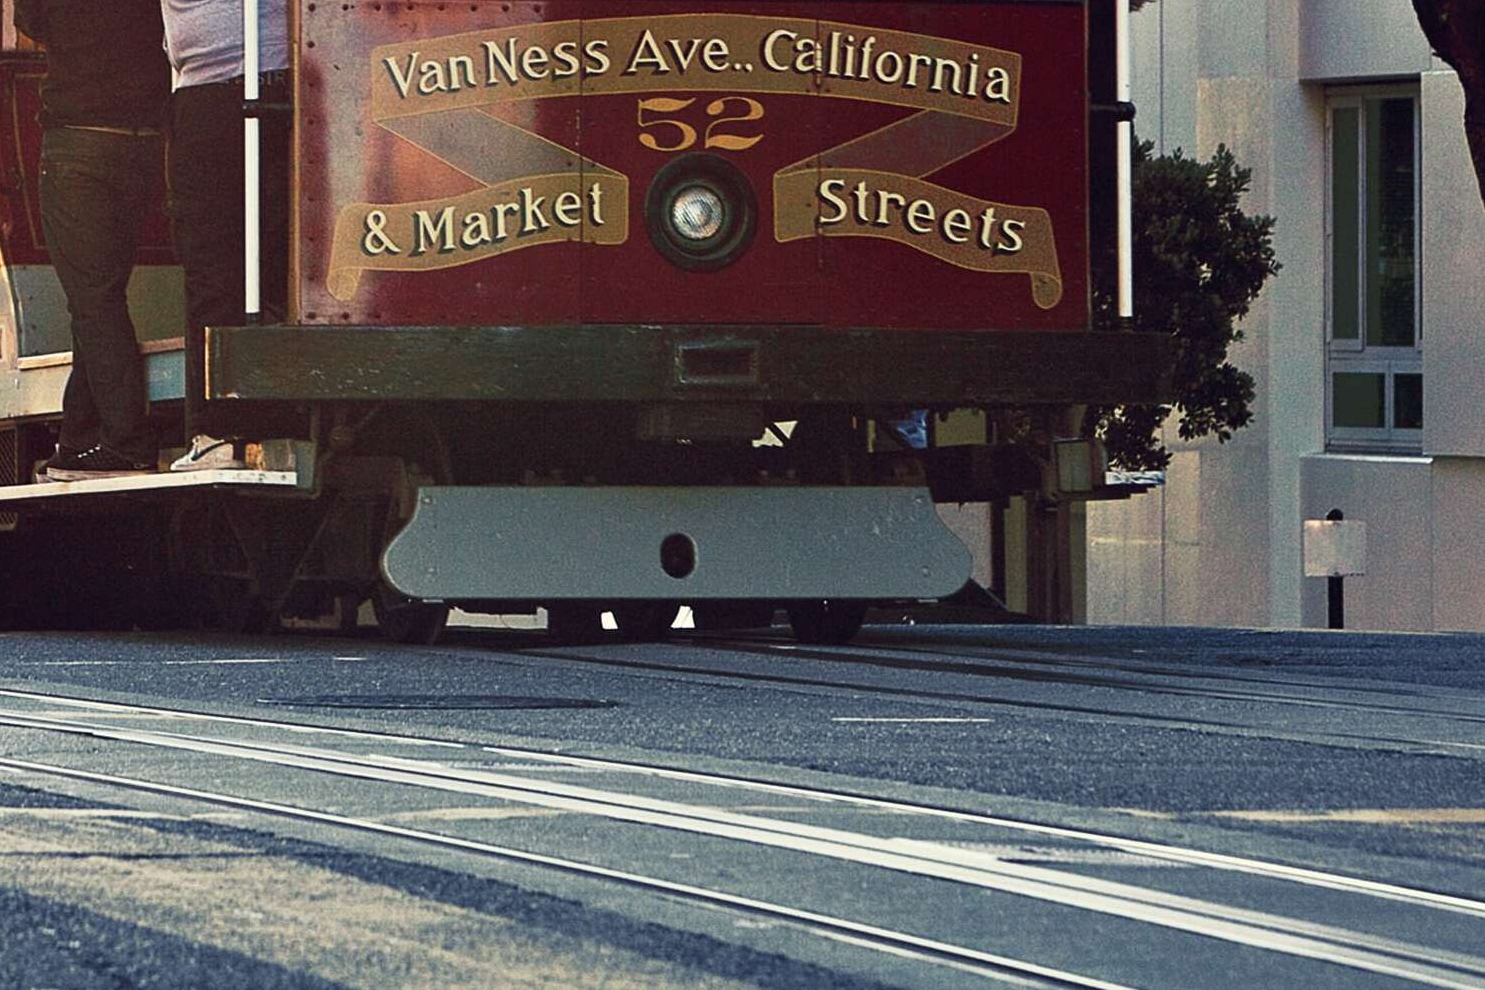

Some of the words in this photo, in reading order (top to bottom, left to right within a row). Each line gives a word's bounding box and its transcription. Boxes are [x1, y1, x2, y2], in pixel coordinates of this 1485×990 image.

[385, 52, 477, 99] Van
[481, 37, 612, 85] Ness
[763, 28, 1012, 104] California
[637, 96, 765, 152] 52
[363, 209, 402, 255] &
[414, 181, 606, 253] Market
[818, 178, 1027, 253] Streets
